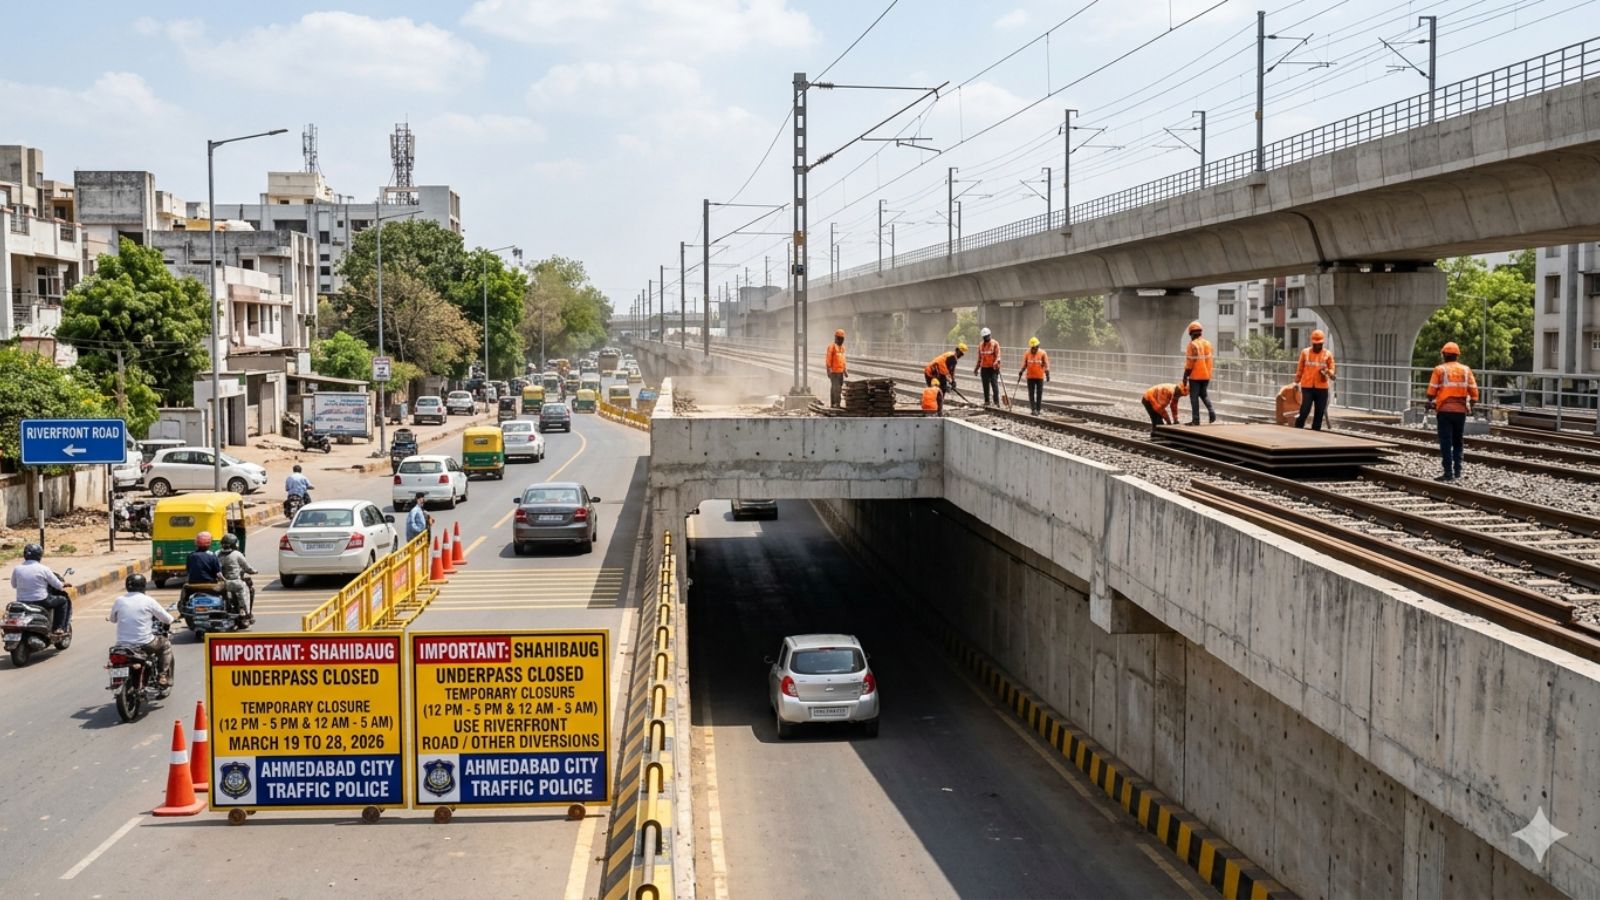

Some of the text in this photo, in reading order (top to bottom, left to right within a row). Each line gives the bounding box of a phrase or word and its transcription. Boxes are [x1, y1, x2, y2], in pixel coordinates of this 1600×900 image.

[27, 427, 120, 439] RIVERFRONT ROAD
[215, 643, 395, 661] IMPORTANT: SHAHIBAUG
[420, 641, 599, 659] IMPORTANT: SHAHIBAUG
[232, 669, 378, 686] UNDERPASS CLOSED
[436, 666, 583, 683] UNDERPASS CLOSED
[445, 688, 517, 700] TEMPORARY
[241, 700, 370, 714] TEMPORARY CLOSURE
[423, 704, 441, 719] (12
[445, 704, 462, 715] PM
[474, 704, 481, 715] 5
[485, 703, 502, 715] PM
[506, 703, 514, 714] &
[519, 703, 532, 714] 12
[536, 702, 553, 714] AM
[575, 701, 597, 716] AM)
[219, 719, 237, 733] (12
[241, 718, 259, 730] PM
[271, 718, 277, 729] 5
[281, 718, 298, 729] PM
[302, 717, 310, 728] &
[315, 717, 327, 728] 12
[332, 717, 349, 728] AM
[361, 716, 367, 728] 5
[371, 716, 393, 731] AM)
[454, 718, 567, 733] USE RIVERFRONT
[229, 735, 384, 751] MARCH 19 TO 28, 2026
[422, 734, 599, 750] ROAD / OTHER DIVERSIONS
[261, 760, 395, 778] AHMEDABAD CITY
[465, 758, 599, 776] AHMEDABAD CITY
[267, 781, 389, 799] TRAFFIC POLICE
[471, 779, 592, 796] TRAFFIC POLICE
